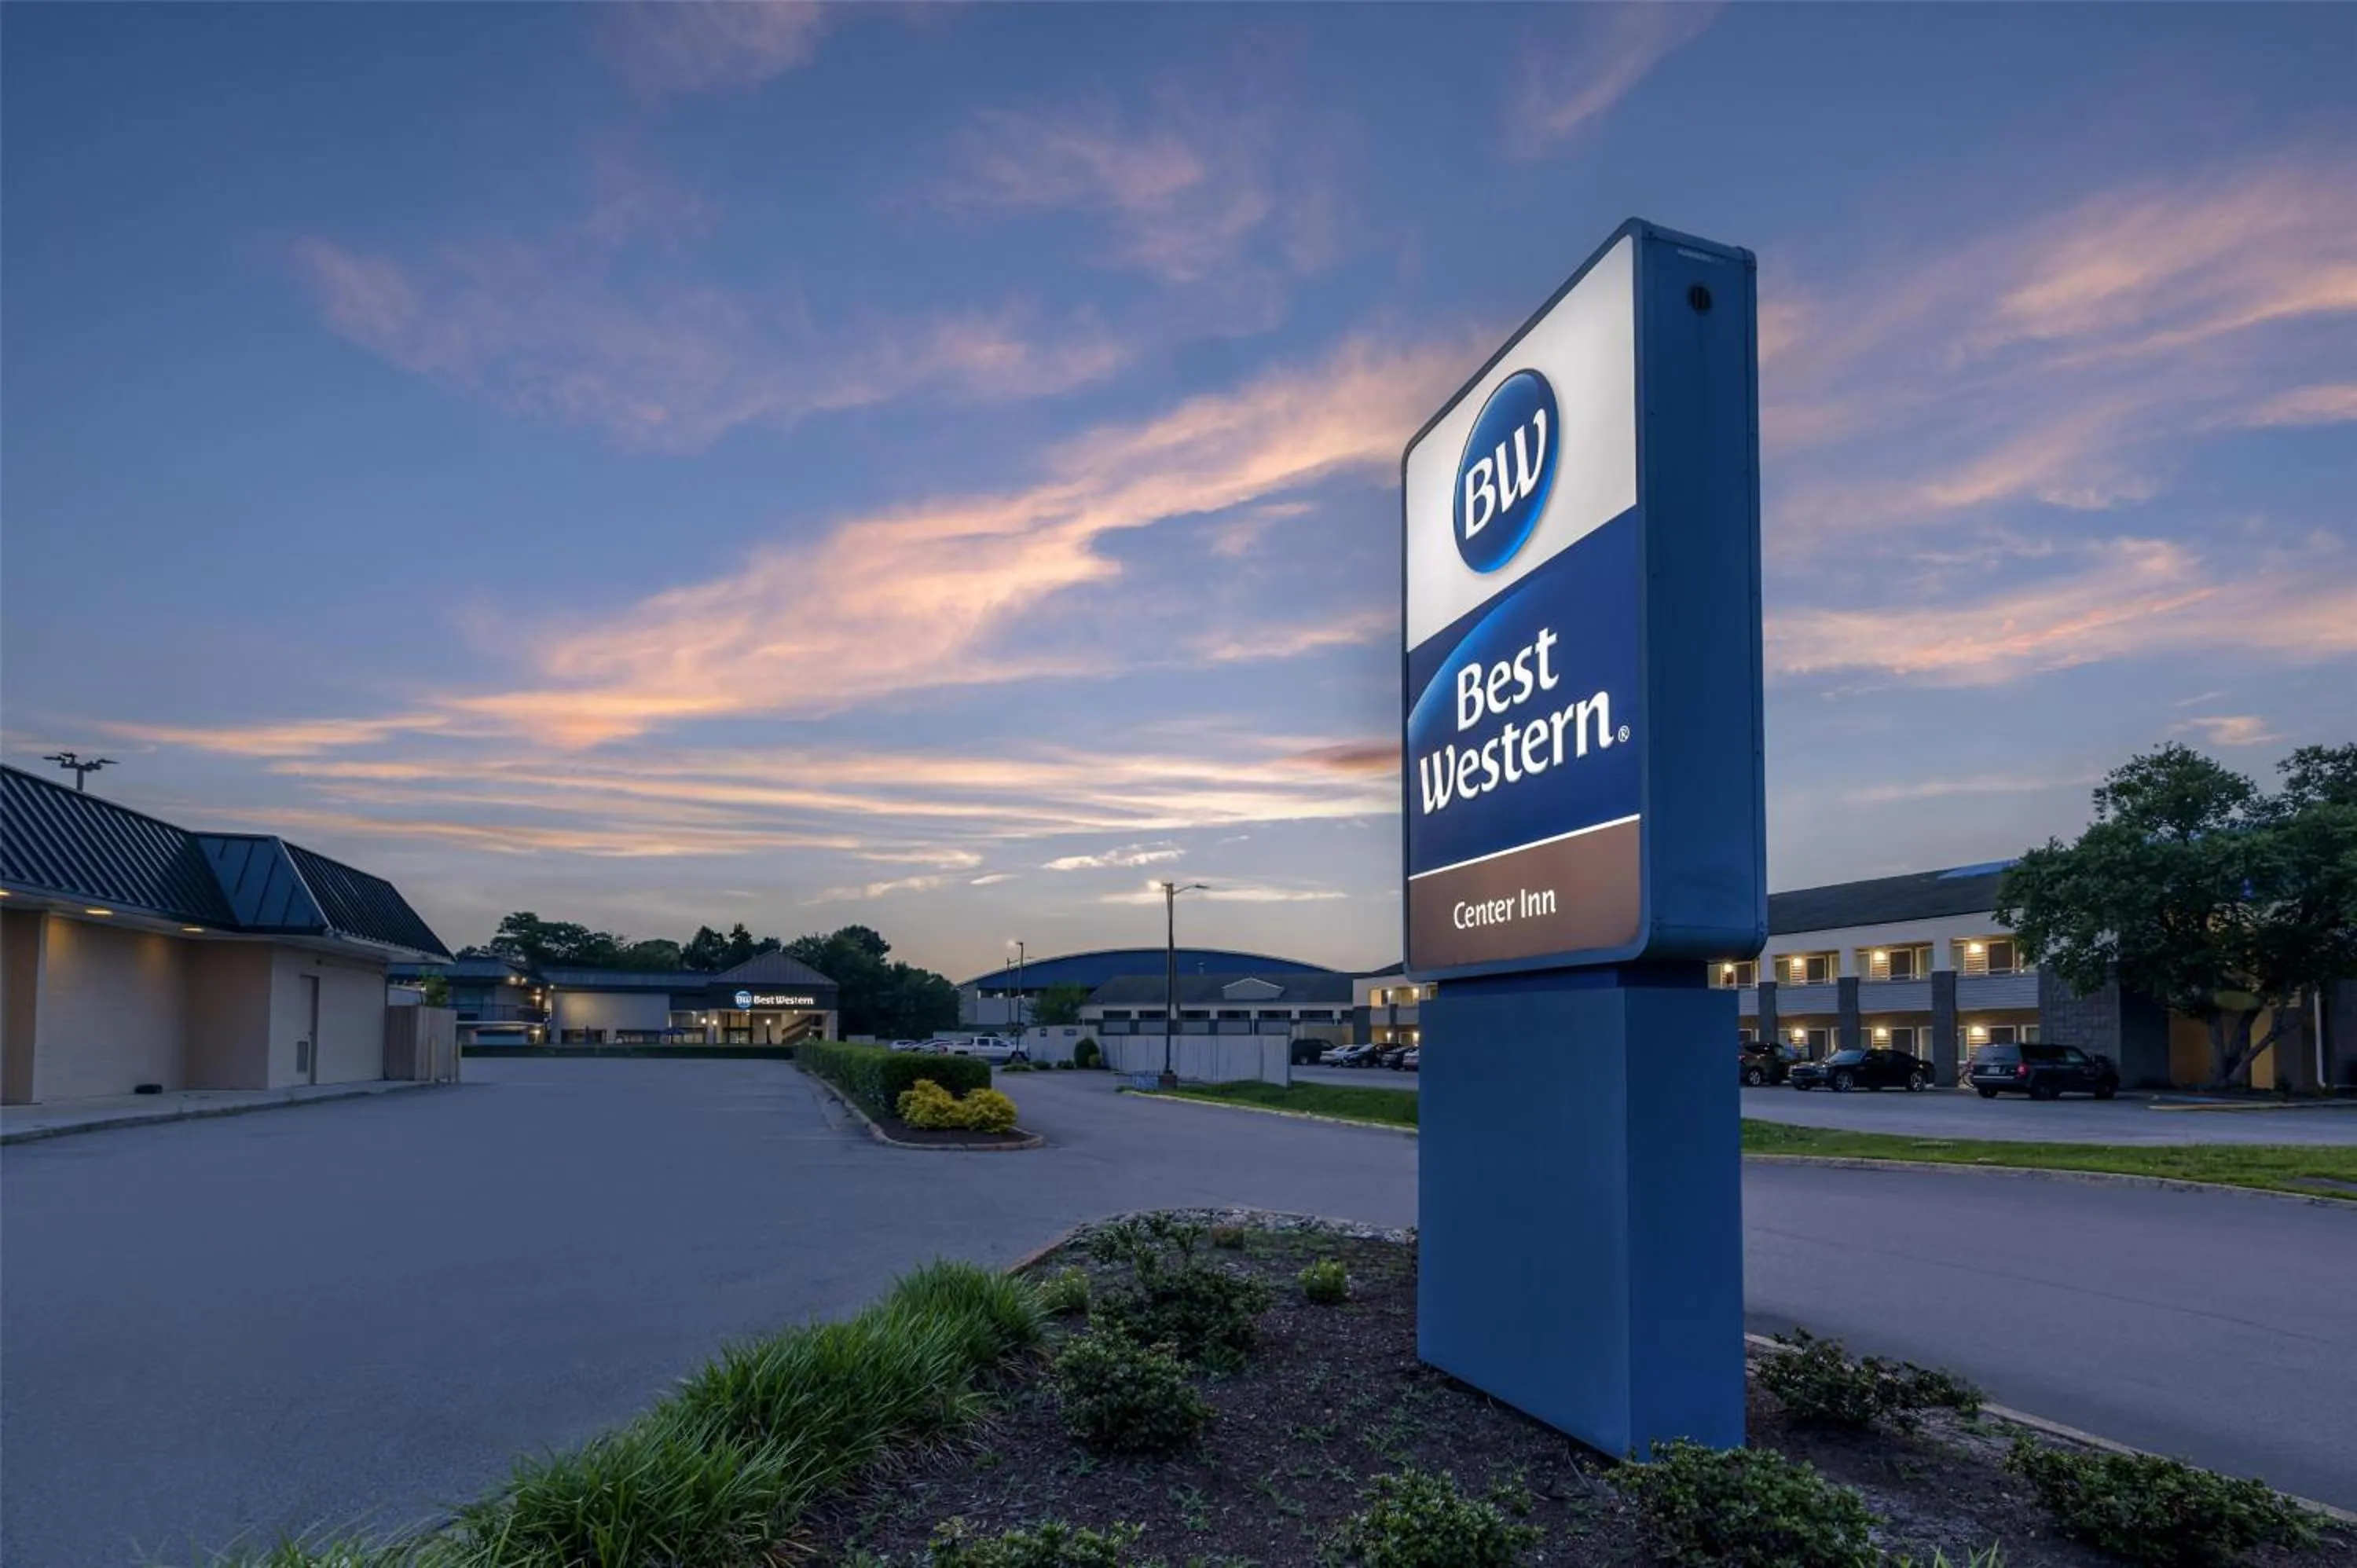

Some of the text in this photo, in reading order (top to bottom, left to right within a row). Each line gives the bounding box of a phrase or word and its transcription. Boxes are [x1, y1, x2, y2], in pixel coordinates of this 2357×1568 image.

[1465, 408, 1547, 540] BW
[1457, 627, 1560, 732] Best
[1453, 888, 1556, 929] Center Inn
[753, 995, 775, 1005] Best
[775, 995, 814, 1005] Western
